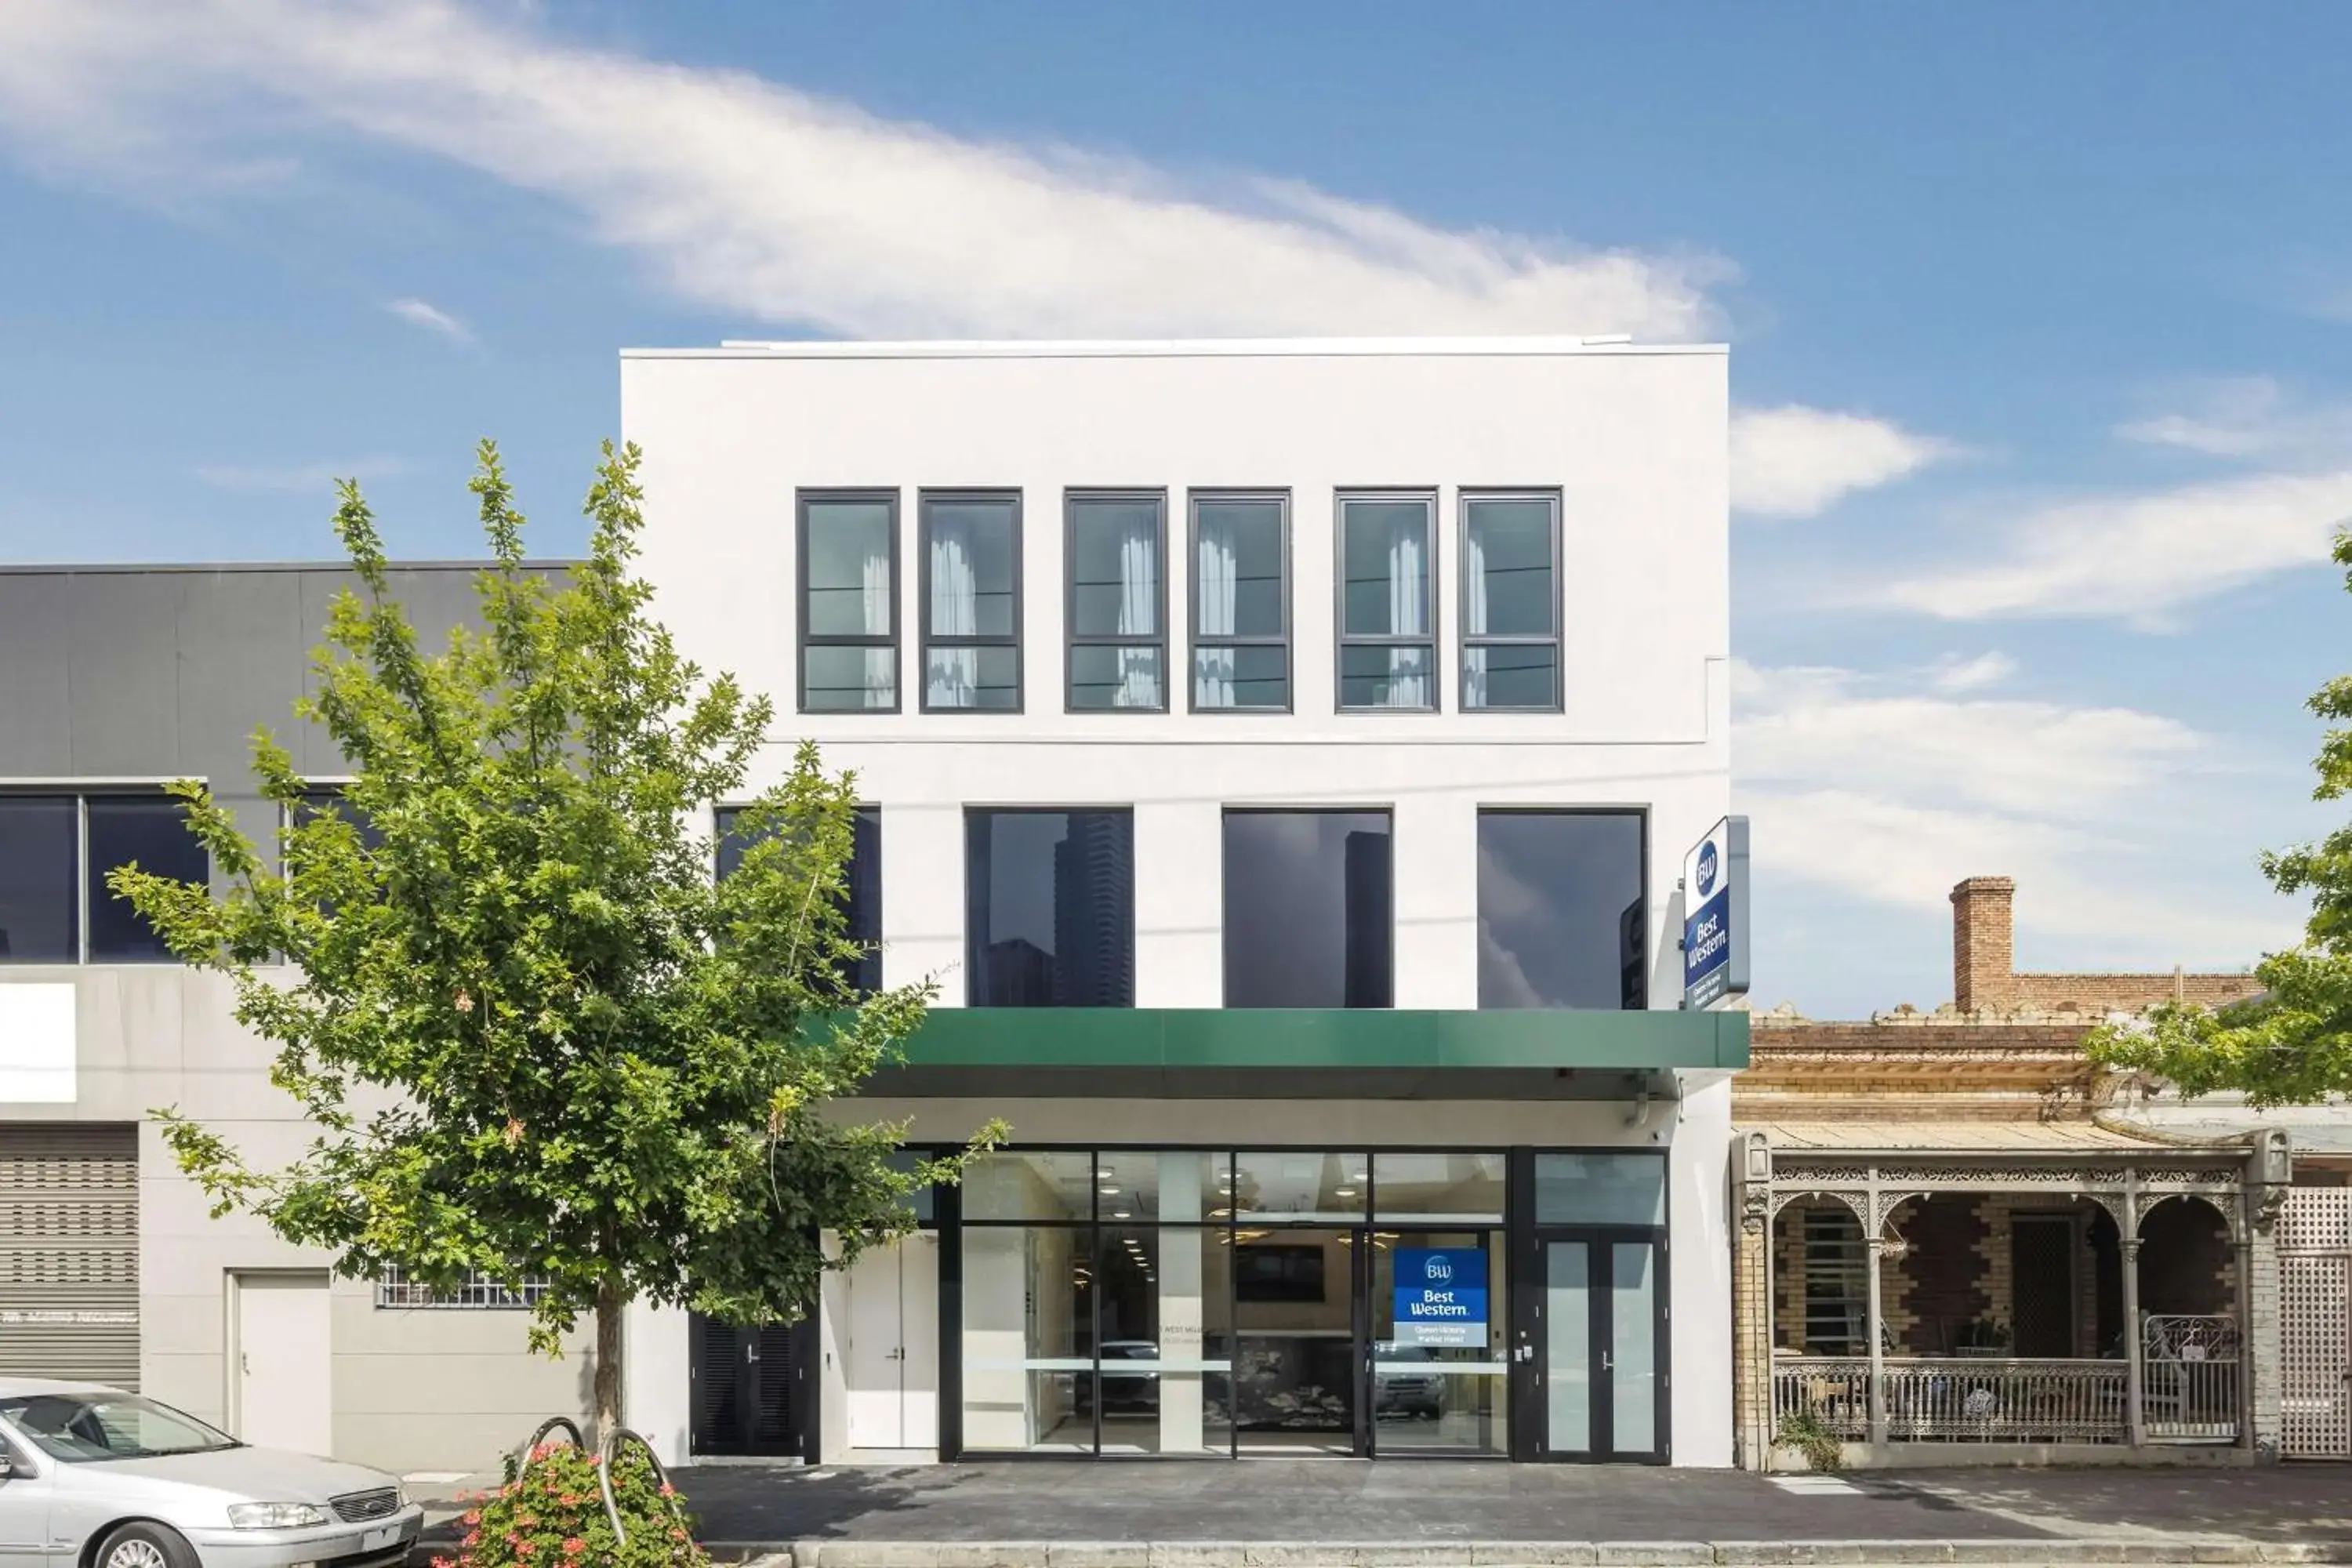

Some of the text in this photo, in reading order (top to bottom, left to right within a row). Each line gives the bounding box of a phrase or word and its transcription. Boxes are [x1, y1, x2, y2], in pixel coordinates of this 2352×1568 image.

[1697, 854, 1715, 885] BW
[1697, 913, 1719, 943] Best
[1688, 929, 1726, 969] Western
[1427, 1265, 1452, 1279] BW
[1424, 1290, 1454, 1303] Best
[1411, 1302, 1467, 1316] Western
